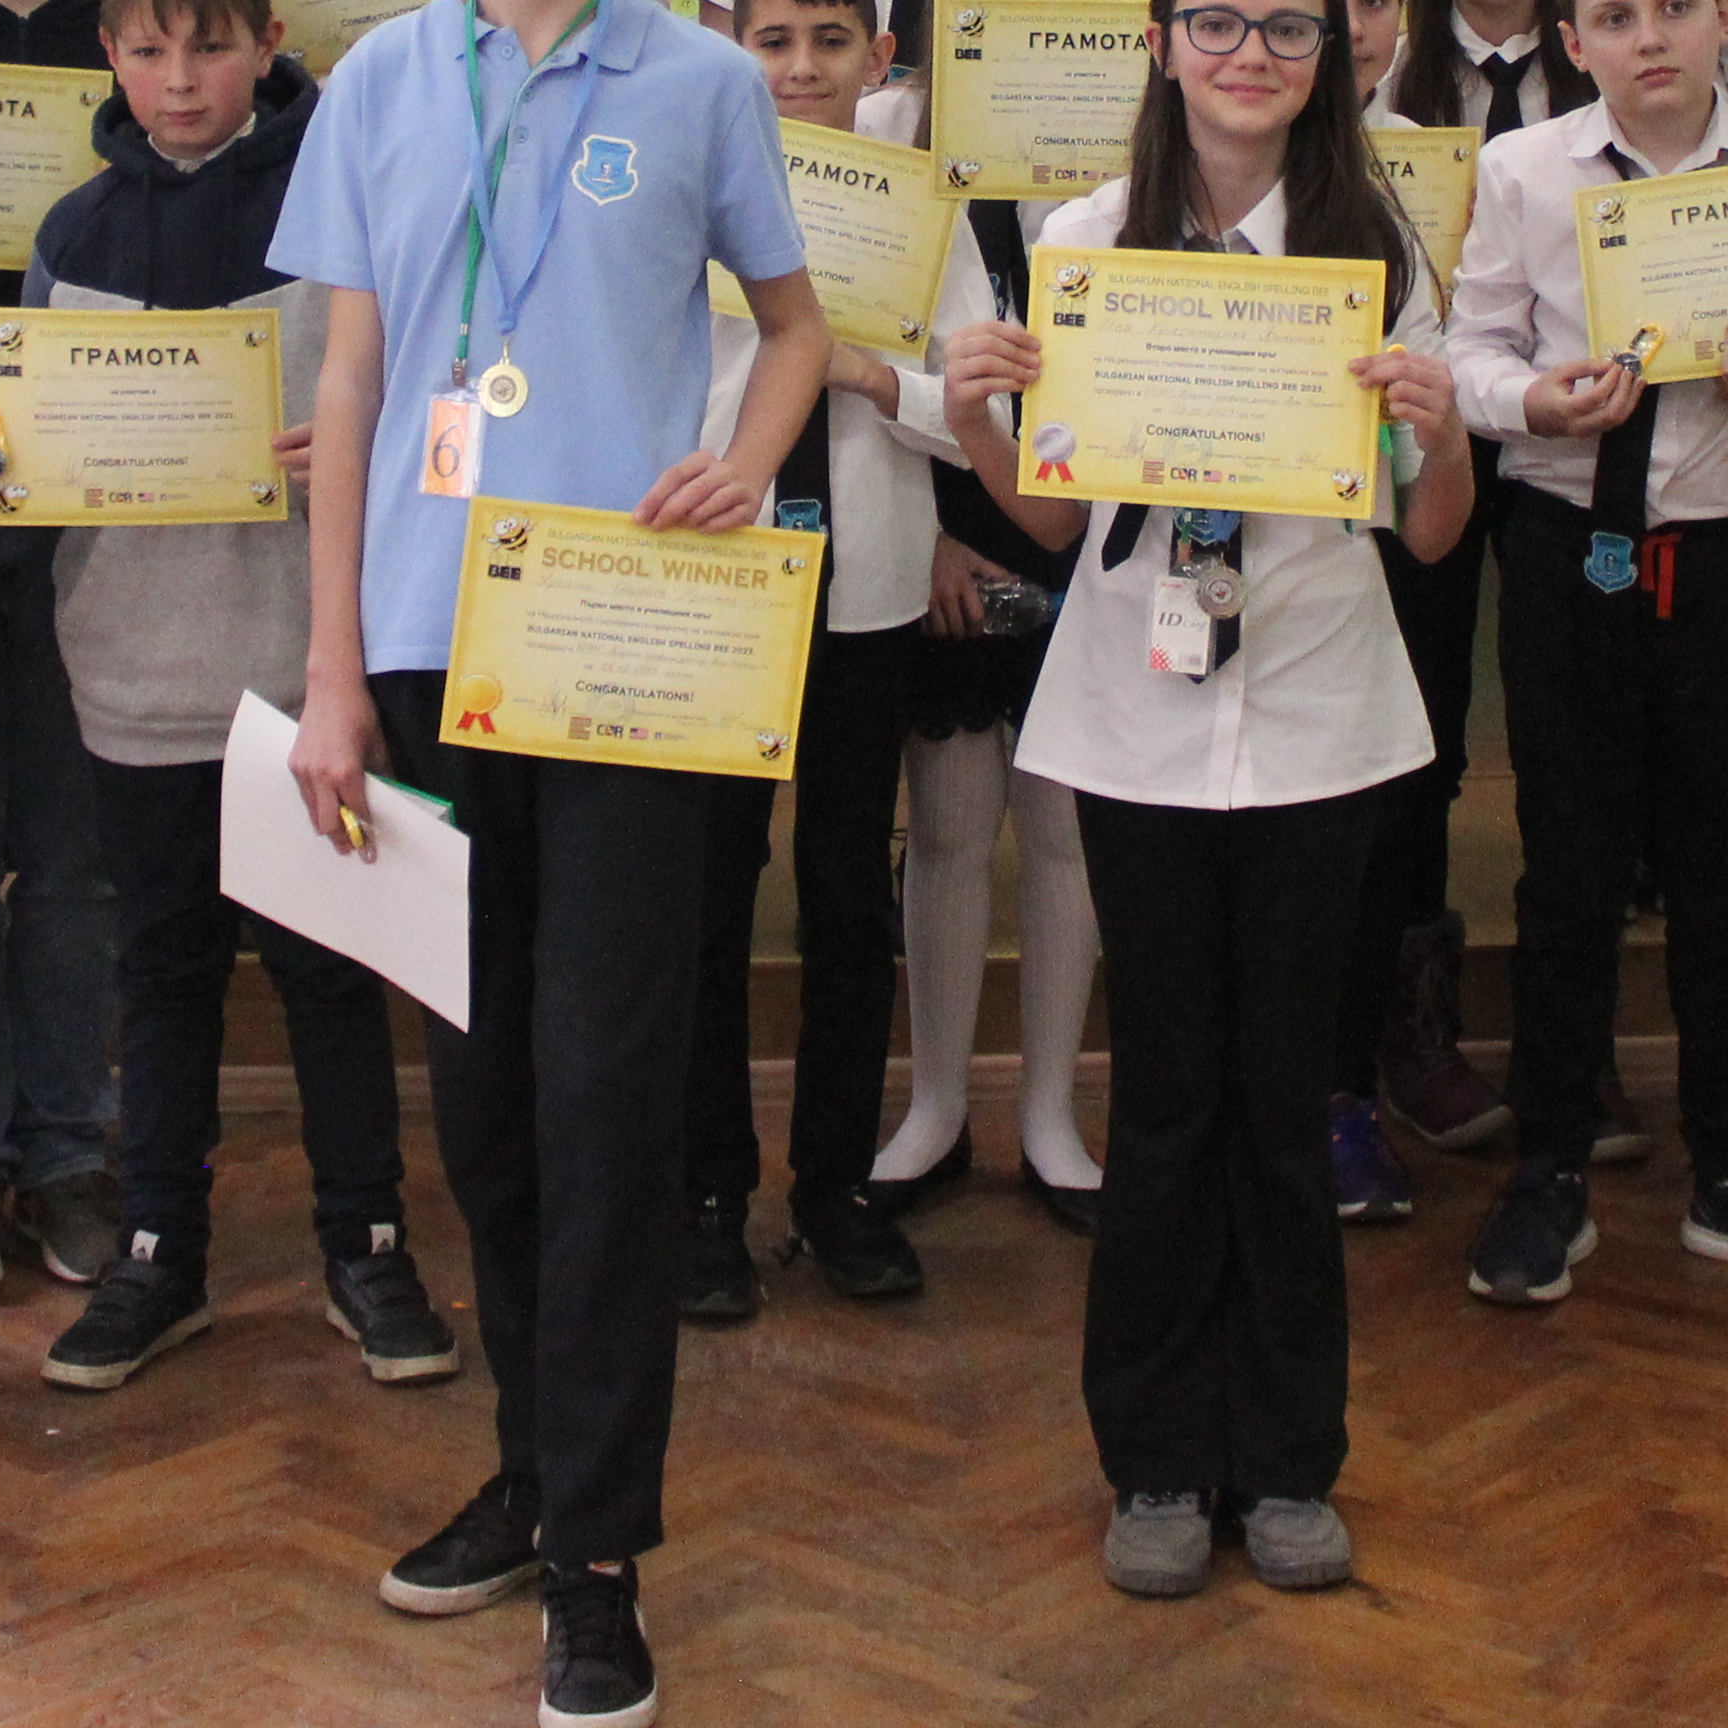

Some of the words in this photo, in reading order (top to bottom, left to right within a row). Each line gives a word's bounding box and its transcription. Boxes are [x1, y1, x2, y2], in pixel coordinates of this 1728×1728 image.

[1028, 32, 1149, 51] ГРАМОТА
[954, 48, 982, 60] BEE
[1034, 135, 1129, 147] CONGRATULATIONS
[782, 154, 891, 195] РАМОТА
[1599, 234, 1627, 249] BEE
[1108, 273, 1165, 286] BULGARIAN
[1166, 277, 1214, 290] NATIONAL
[1217, 280, 1261, 292] ENGLISH
[1262, 283, 1310, 295] SPELLING
[1104, 291, 1212, 319] SCHOOL
[1223, 298, 1332, 326] WINNER
[1053, 313, 1086, 327] BEE
[70, 347, 200, 366] ГРАМОТА
[1094, 370, 1145, 381] BULGARIAN
[1147, 373, 1192, 384] NATIONAL
[1194, 377, 1234, 387] ENGLISH
[1236, 379, 1279, 390] SPELLING
[1281, 383, 1298, 391] BEE
[1145, 423, 1266, 444] CONGRATULATIONS!
[431, 422, 462, 478] 6
[83, 456, 189, 468] CONGRATULATIONS!
[487, 563, 521, 582] BEE
[541, 545, 650, 578] SCHOOL
[661, 558, 769, 591] WINNER
[1158, 611, 1183, 628] ID
[527, 624, 578, 638] BULGARIAN
[580, 630, 625, 644] NATIONAL
[627, 636, 666, 647] ENGLISH
[668, 640, 711, 651] SPELLING
[713, 644, 730, 653] BEE
[575, 680, 694, 703] CONGRATULATIONS!
